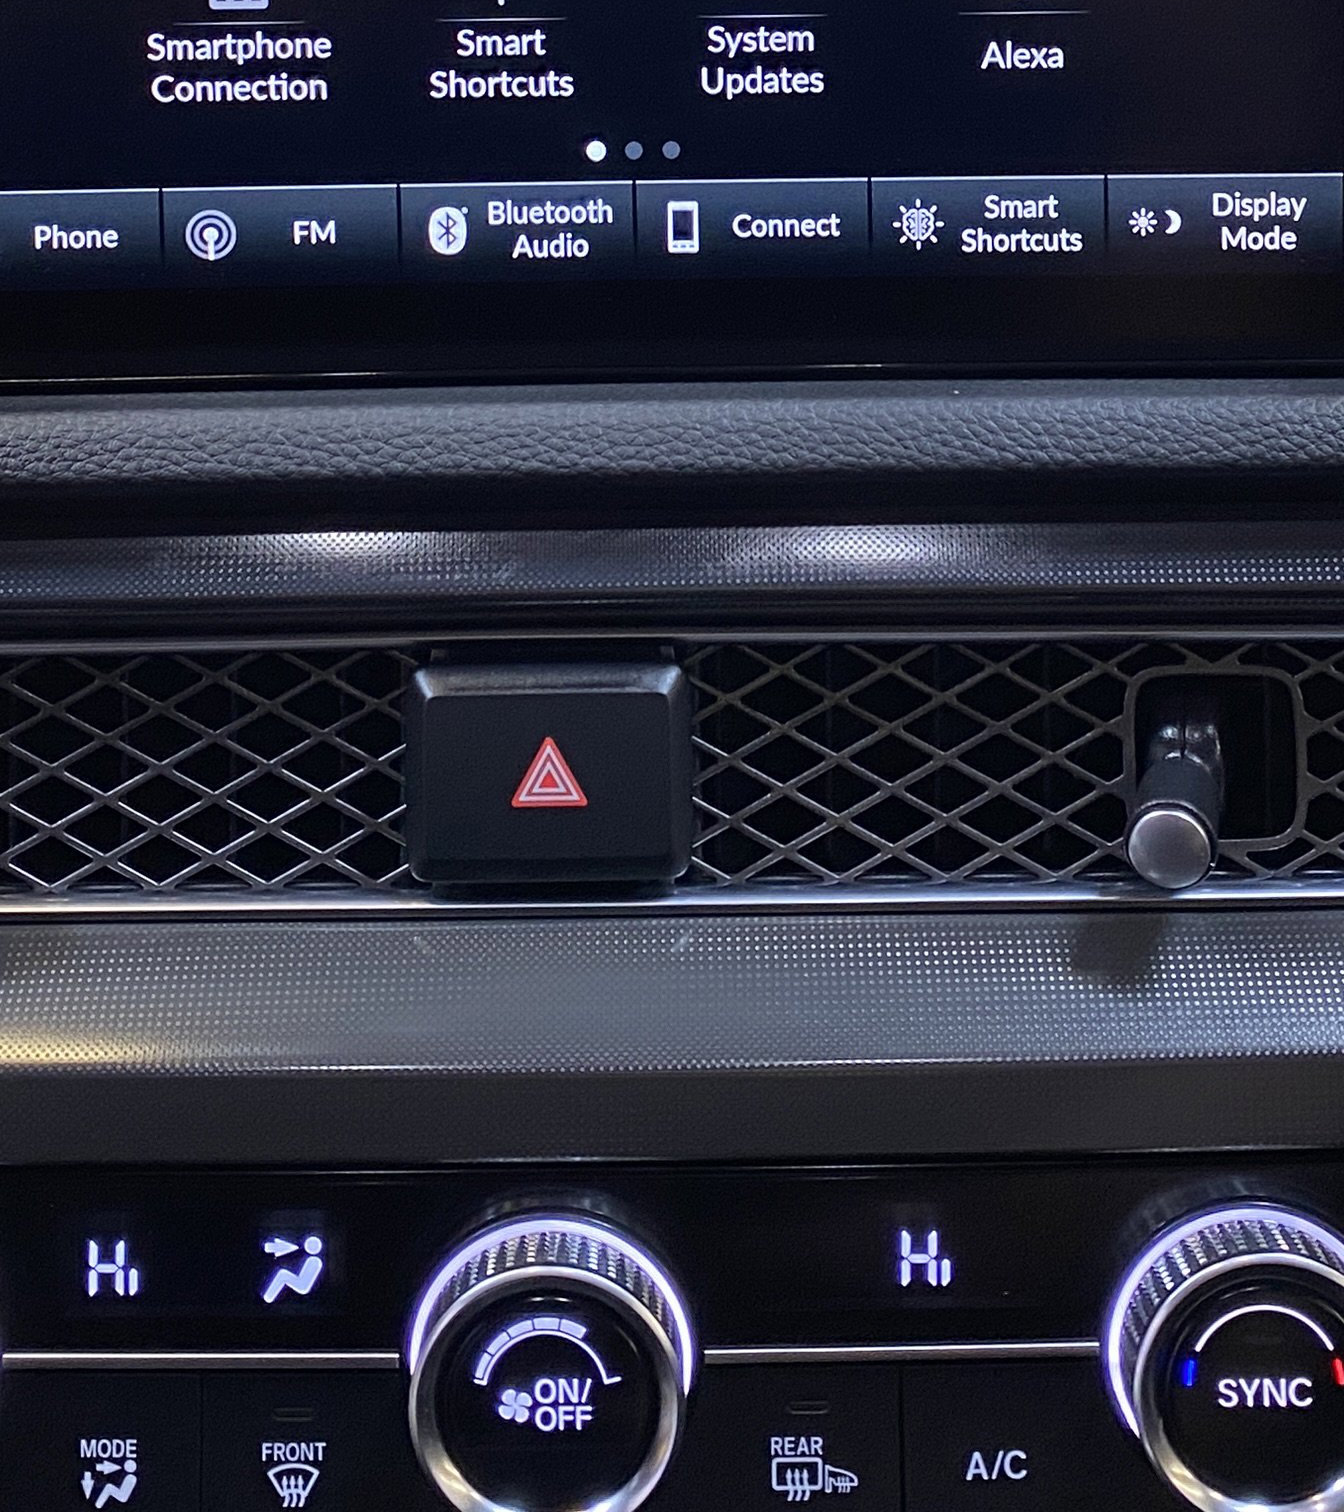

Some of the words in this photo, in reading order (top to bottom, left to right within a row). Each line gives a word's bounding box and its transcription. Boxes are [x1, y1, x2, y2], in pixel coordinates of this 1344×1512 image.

[147, 31, 332, 65] Smartphone
[457, 29, 546, 56] Smart
[708, 26, 814, 58] System
[981, 41, 1063, 69] Alexa
[151, 72, 327, 102] Connection
[430, 70, 574, 98] Shortcuts
[701, 66, 824, 100] Updates
[488, 198, 613, 225] Bluetooth
[984, 195, 1058, 219] Smart
[1211, 191, 1308, 223] Display
[35, 224, 118, 249] Phone
[294, 220, 336, 244] FM
[732, 214, 840, 237] Connect
[1222, 225, 1297, 250] Mode
[512, 232, 589, 258] Audio
[962, 228, 1082, 252] Shortcuts
[533, 1377, 593, 1405] ON/
[1218, 1377, 1313, 1407] SYNC
[534, 1405, 594, 1432] OFF
[79, 1438, 138, 1459] MODE
[261, 1441, 327, 1462] FRONT
[770, 1436, 824, 1456] REAR
[966, 1450, 1027, 1480] A/C
